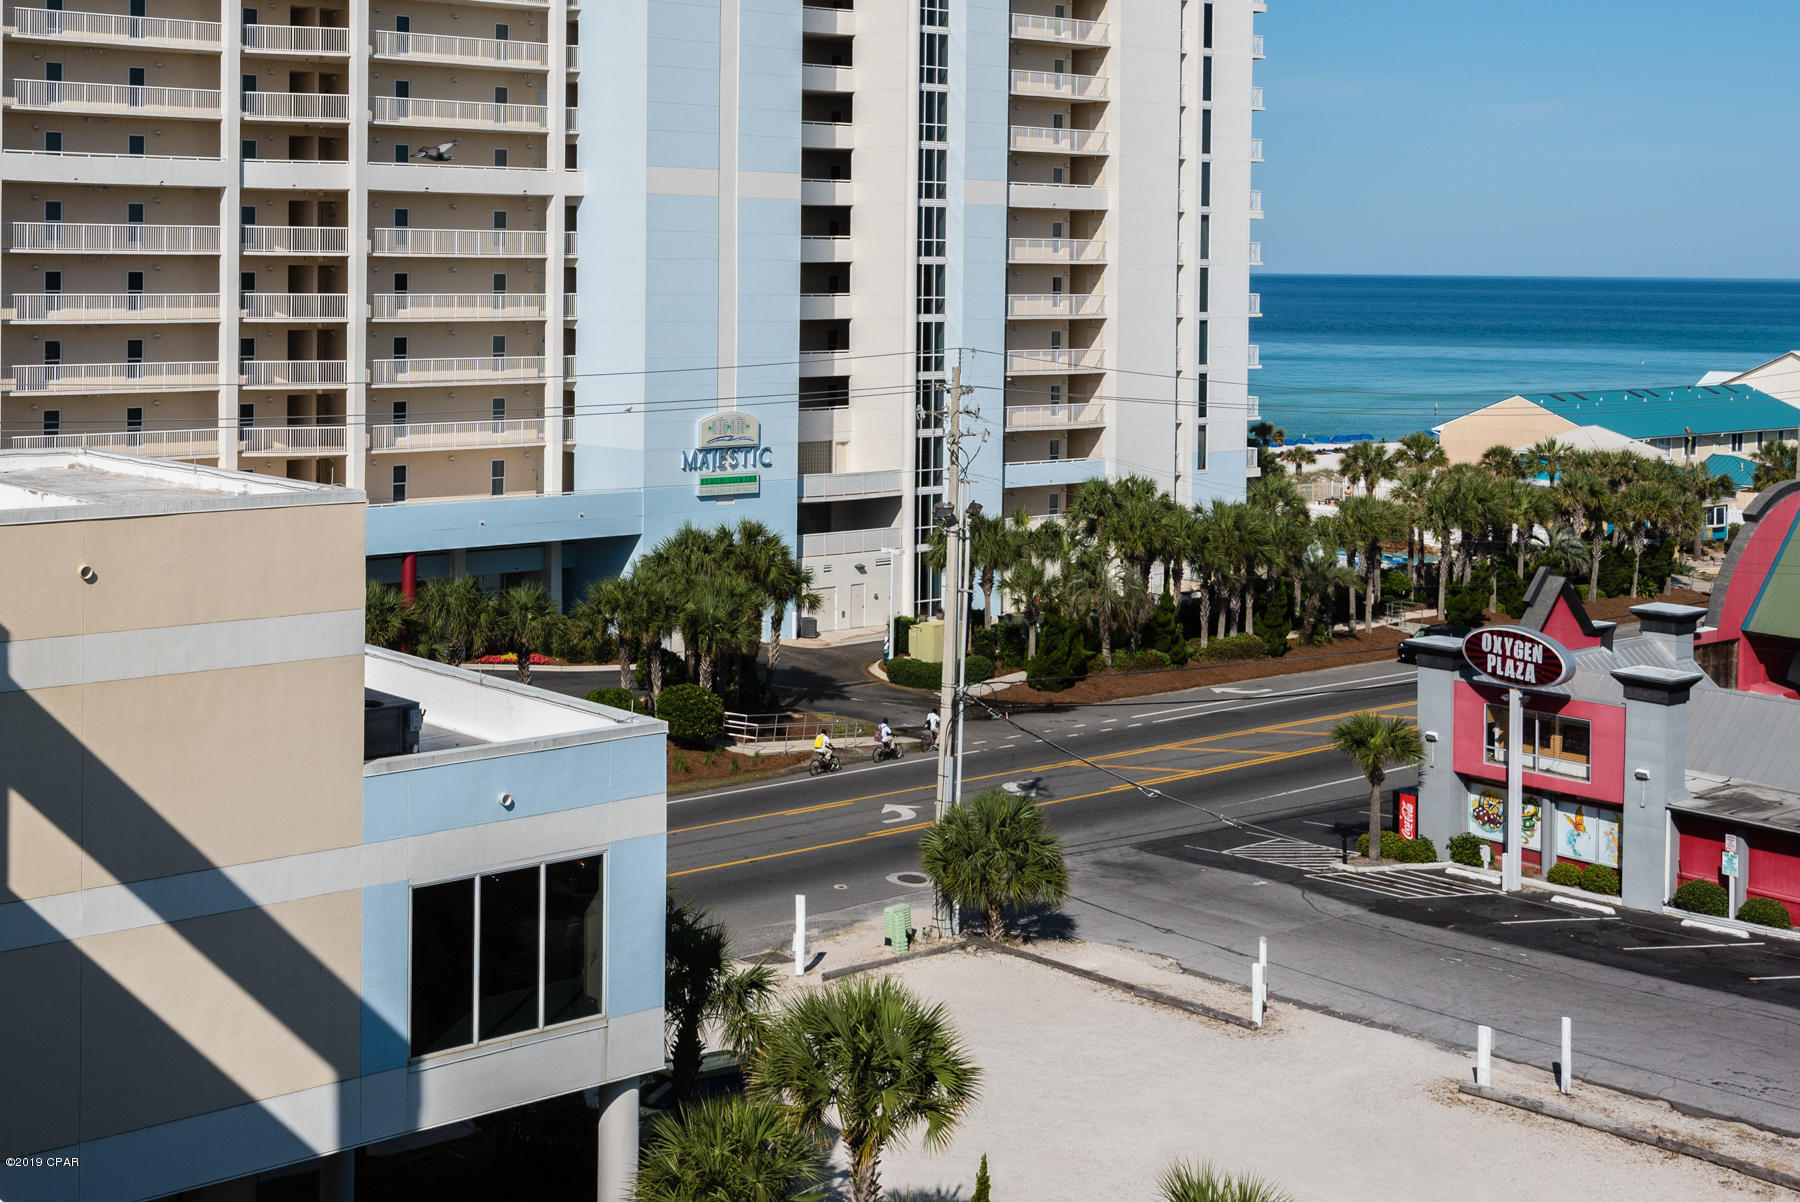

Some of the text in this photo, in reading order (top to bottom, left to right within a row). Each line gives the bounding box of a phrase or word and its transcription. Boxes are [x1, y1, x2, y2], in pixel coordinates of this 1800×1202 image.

[681, 446, 773, 472] MAJESTIC
[1481, 632, 1543, 664] OXYGEN
[1486, 653, 1537, 684] PLAZA
[1488, 800, 1497, 812] 7
